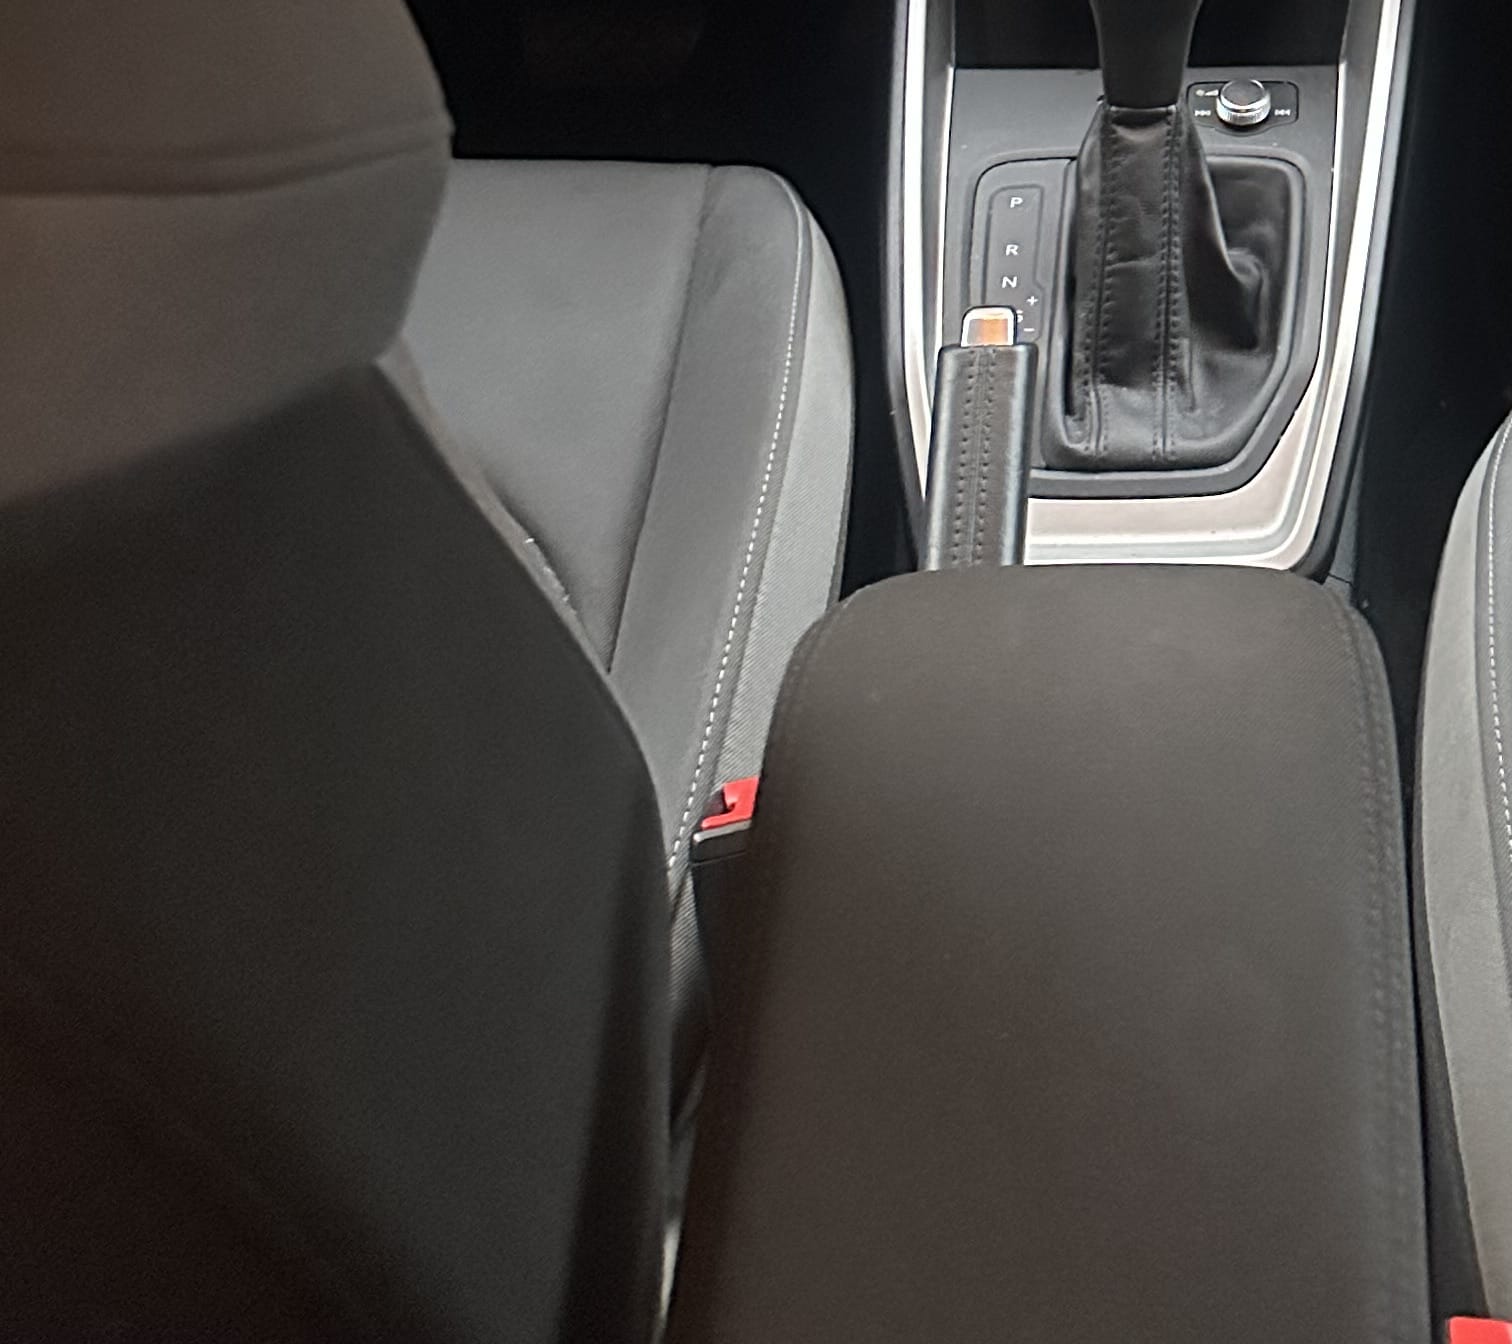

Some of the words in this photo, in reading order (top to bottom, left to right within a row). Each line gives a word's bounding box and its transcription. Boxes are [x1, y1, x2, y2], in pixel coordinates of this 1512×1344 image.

[1009, 196, 1024, 209] P
[1005, 243, 1019, 256] R
[1001, 275, 1018, 289] N
